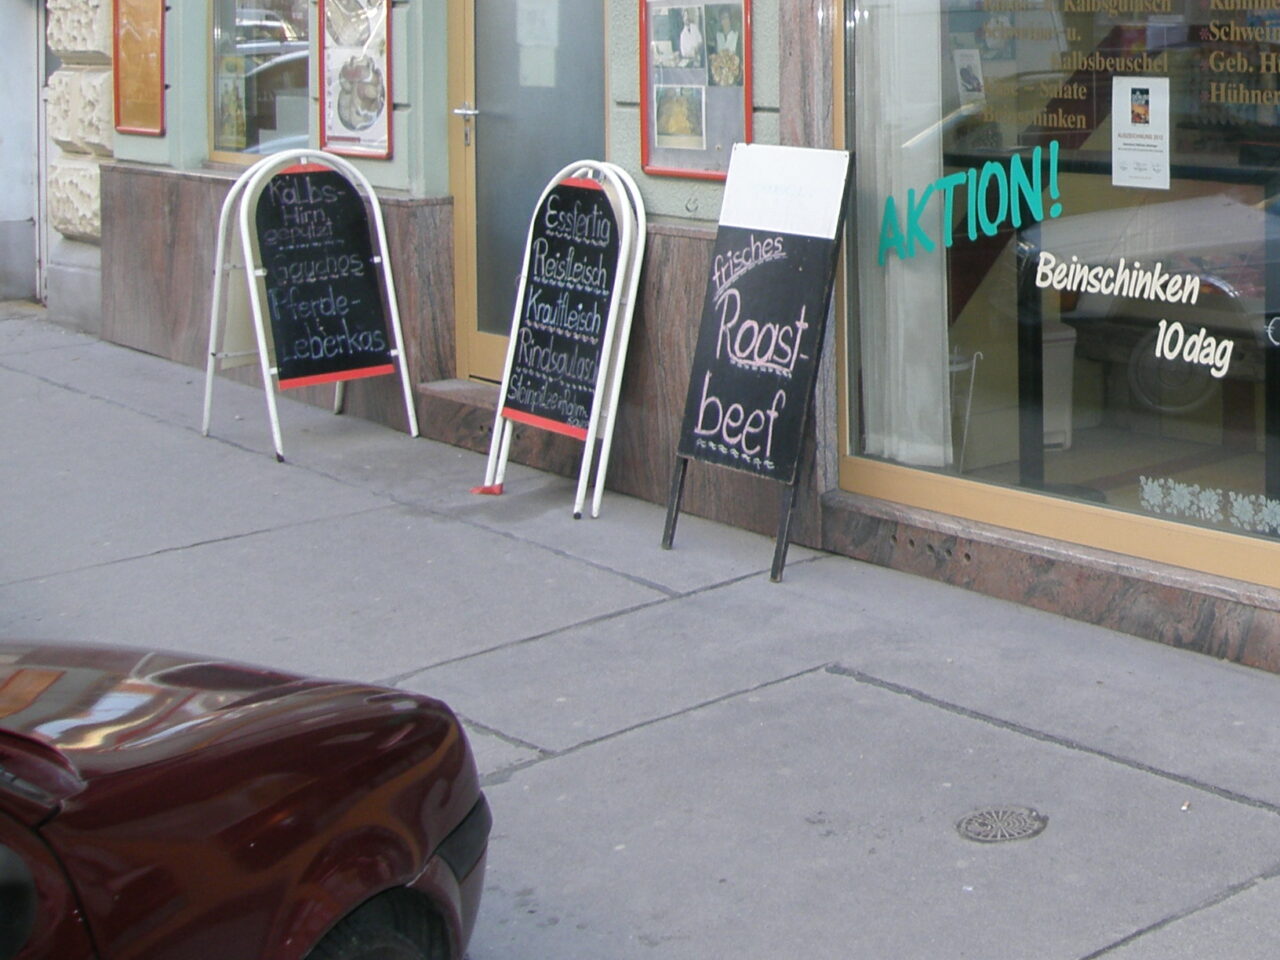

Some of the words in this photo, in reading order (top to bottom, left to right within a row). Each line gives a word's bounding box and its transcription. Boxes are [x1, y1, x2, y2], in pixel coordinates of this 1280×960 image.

[1209, 51, 1254, 73] Geb.
[1040, 79, 1087, 101] Salate
[545, 194, 611, 248] Essfertig
[877, 140, 1062, 267] AKTION!
[533, 237, 607, 289] Reisfleisch
[713, 234, 784, 289] frisches
[1036, 250, 1200, 305] Beinschinken
[525, 285, 601, 333] Krautfleisch
[715, 287, 808, 371] Roast
[695, 372, 786, 457] beef
